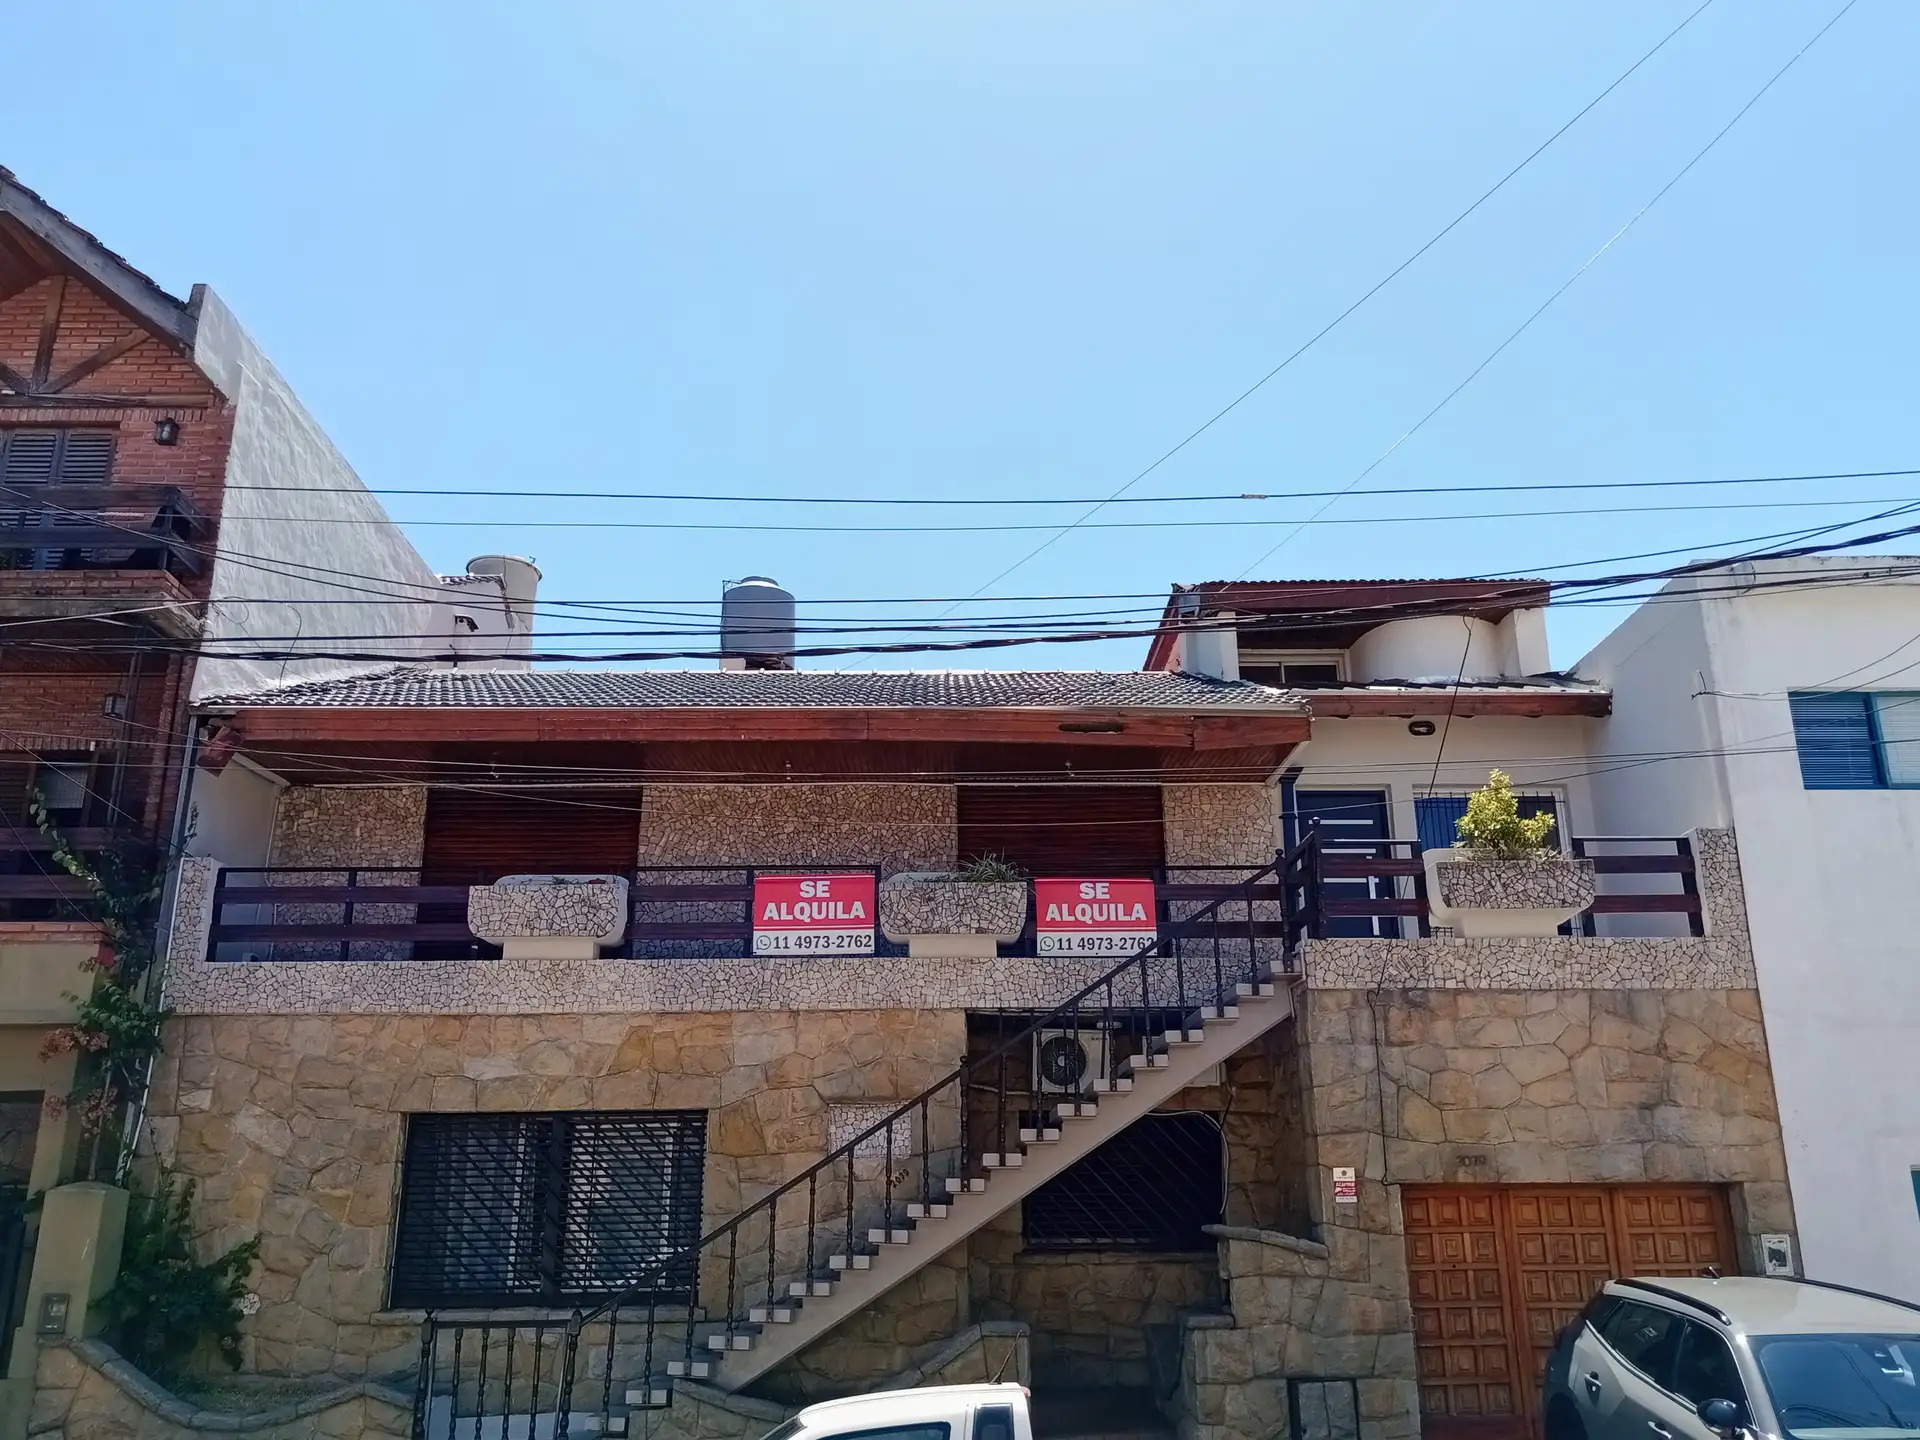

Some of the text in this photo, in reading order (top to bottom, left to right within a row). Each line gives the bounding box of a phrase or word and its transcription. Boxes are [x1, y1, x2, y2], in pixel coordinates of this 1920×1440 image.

[799, 880, 831, 898] SE
[1079, 882, 1110, 899] SE
[762, 901, 866, 923] ALQUILA
[1045, 903, 1147, 924] ALQUILA
[773, 934, 872, 949] 11 4973-2762
[1057, 937, 1073, 951] 11
